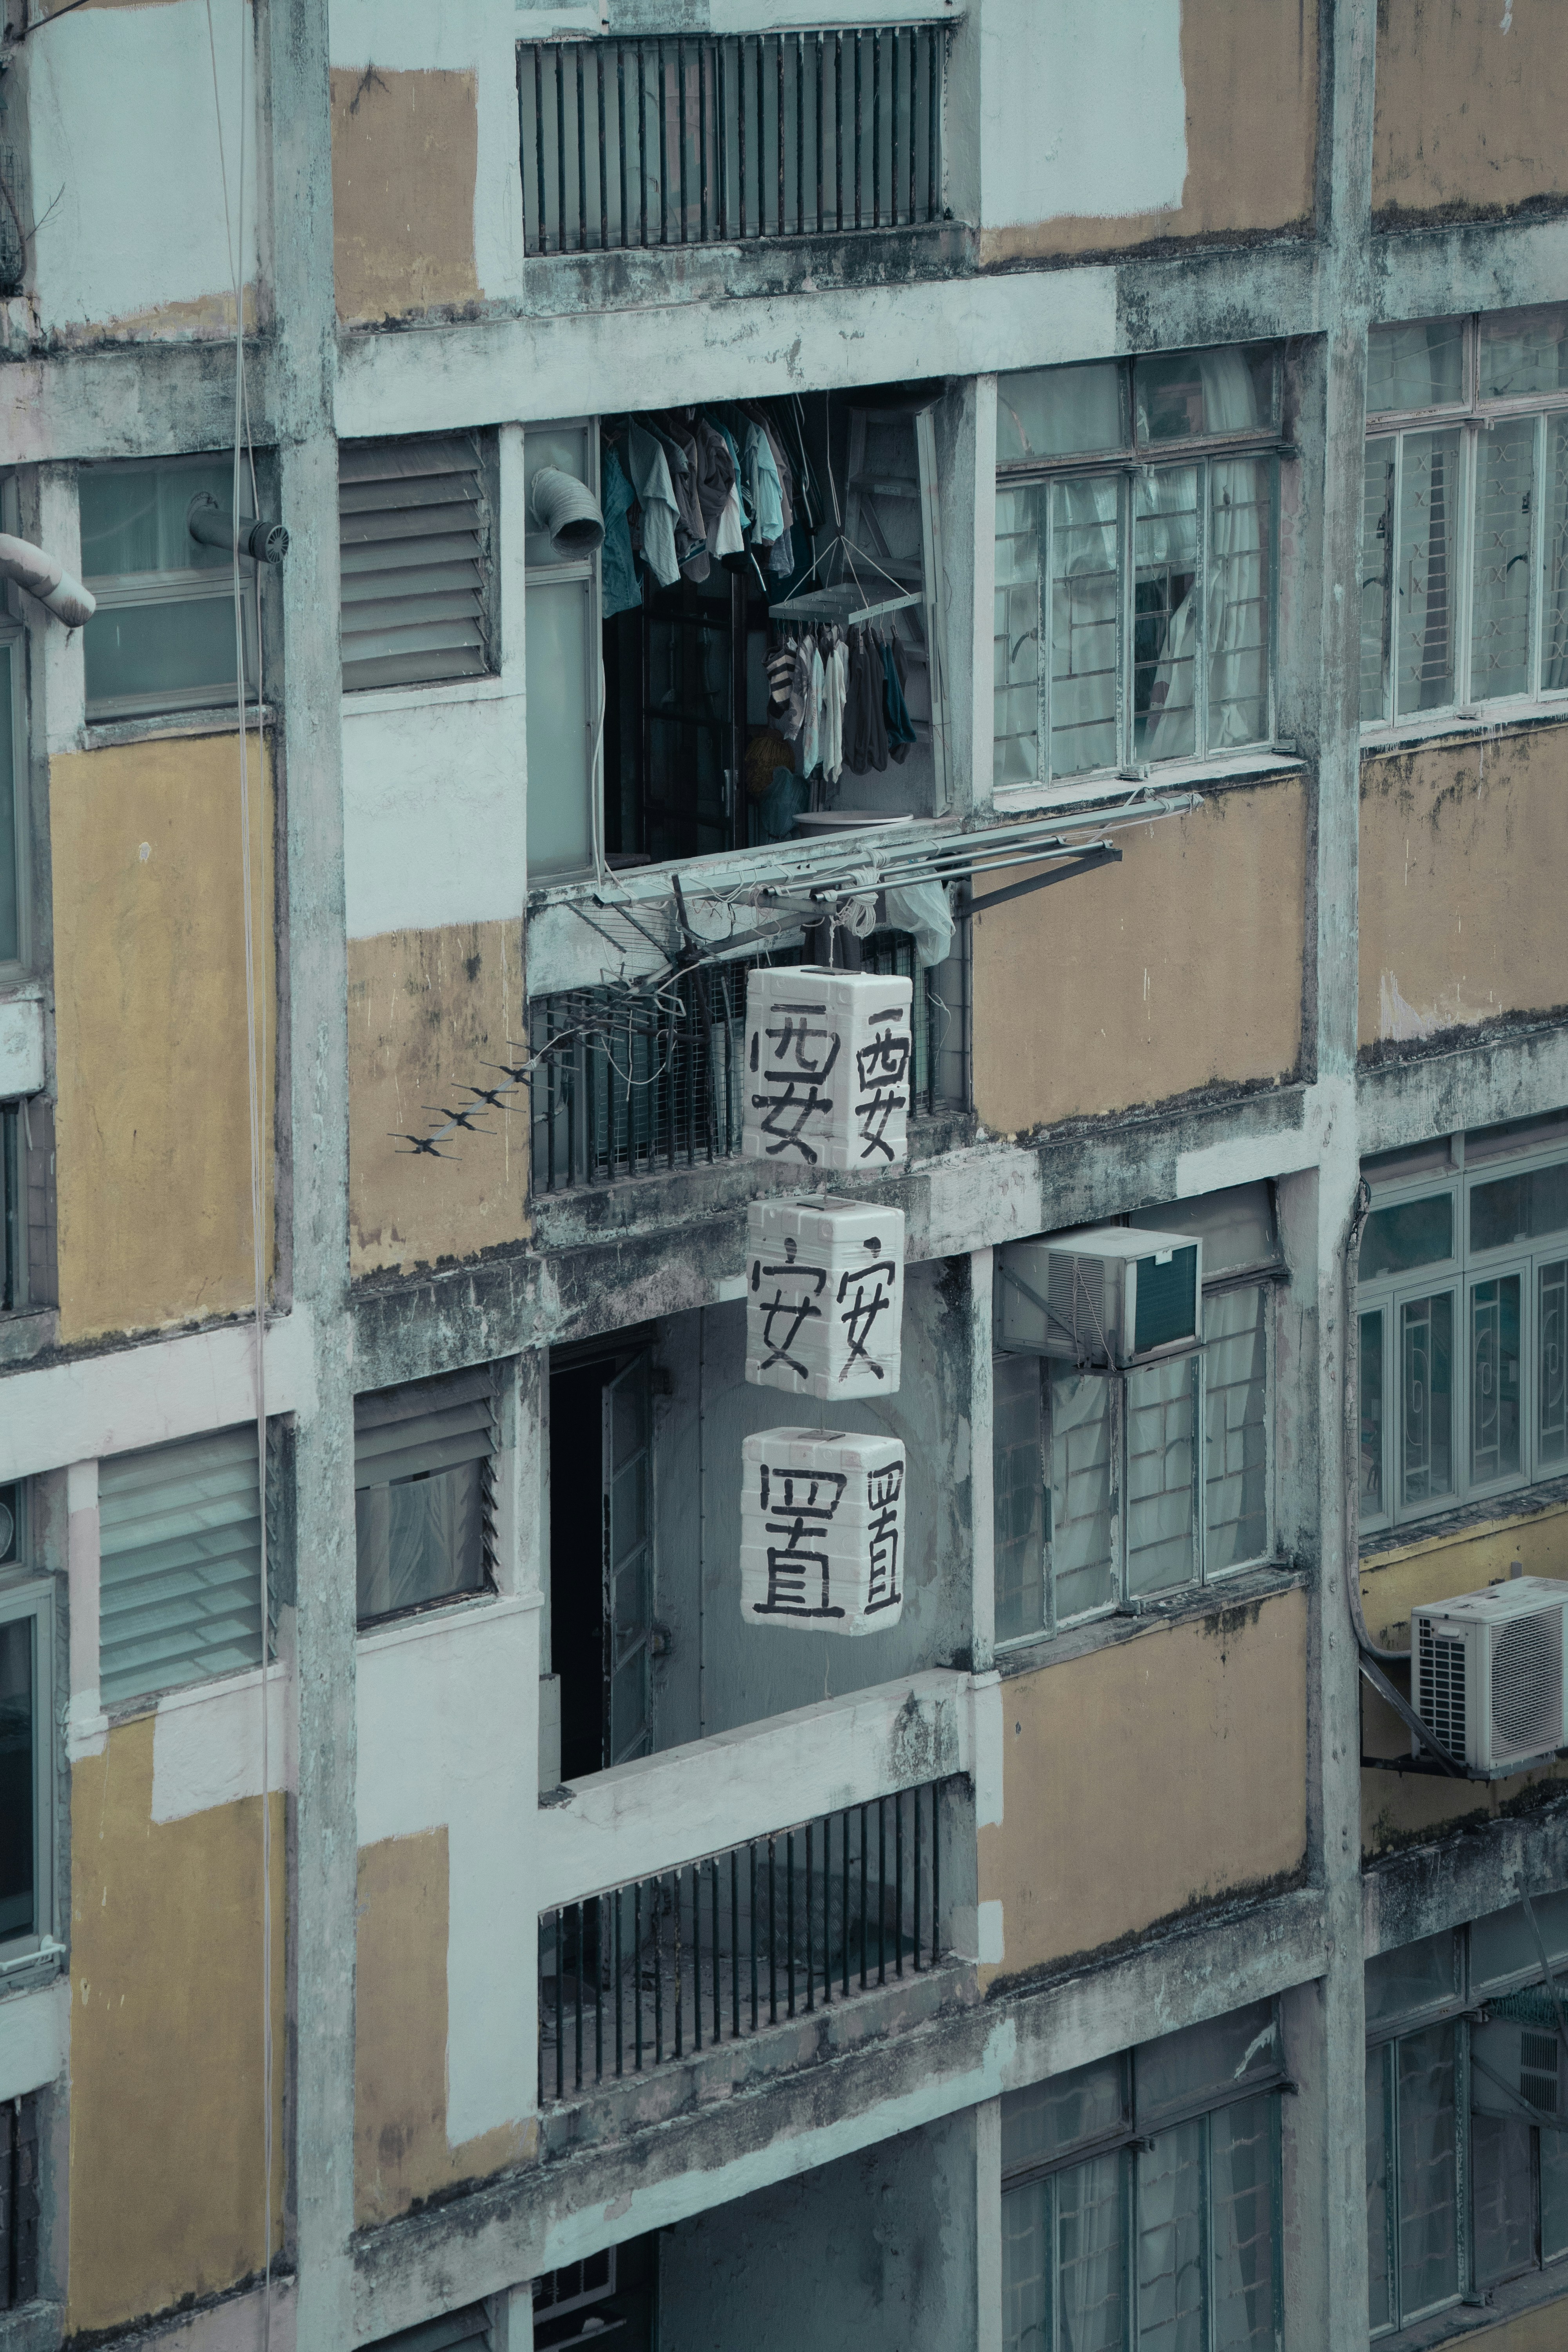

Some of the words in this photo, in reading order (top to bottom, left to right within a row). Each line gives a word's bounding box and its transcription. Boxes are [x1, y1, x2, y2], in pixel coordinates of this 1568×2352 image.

[750, 1004, 841, 1164] 要
[855, 1008, 909, 1161] 要
[752, 1238, 827, 1379] 安
[837, 1236, 895, 1383] 安
[752, 1464, 847, 1618] 置
[864, 1460, 904, 1615] 置
